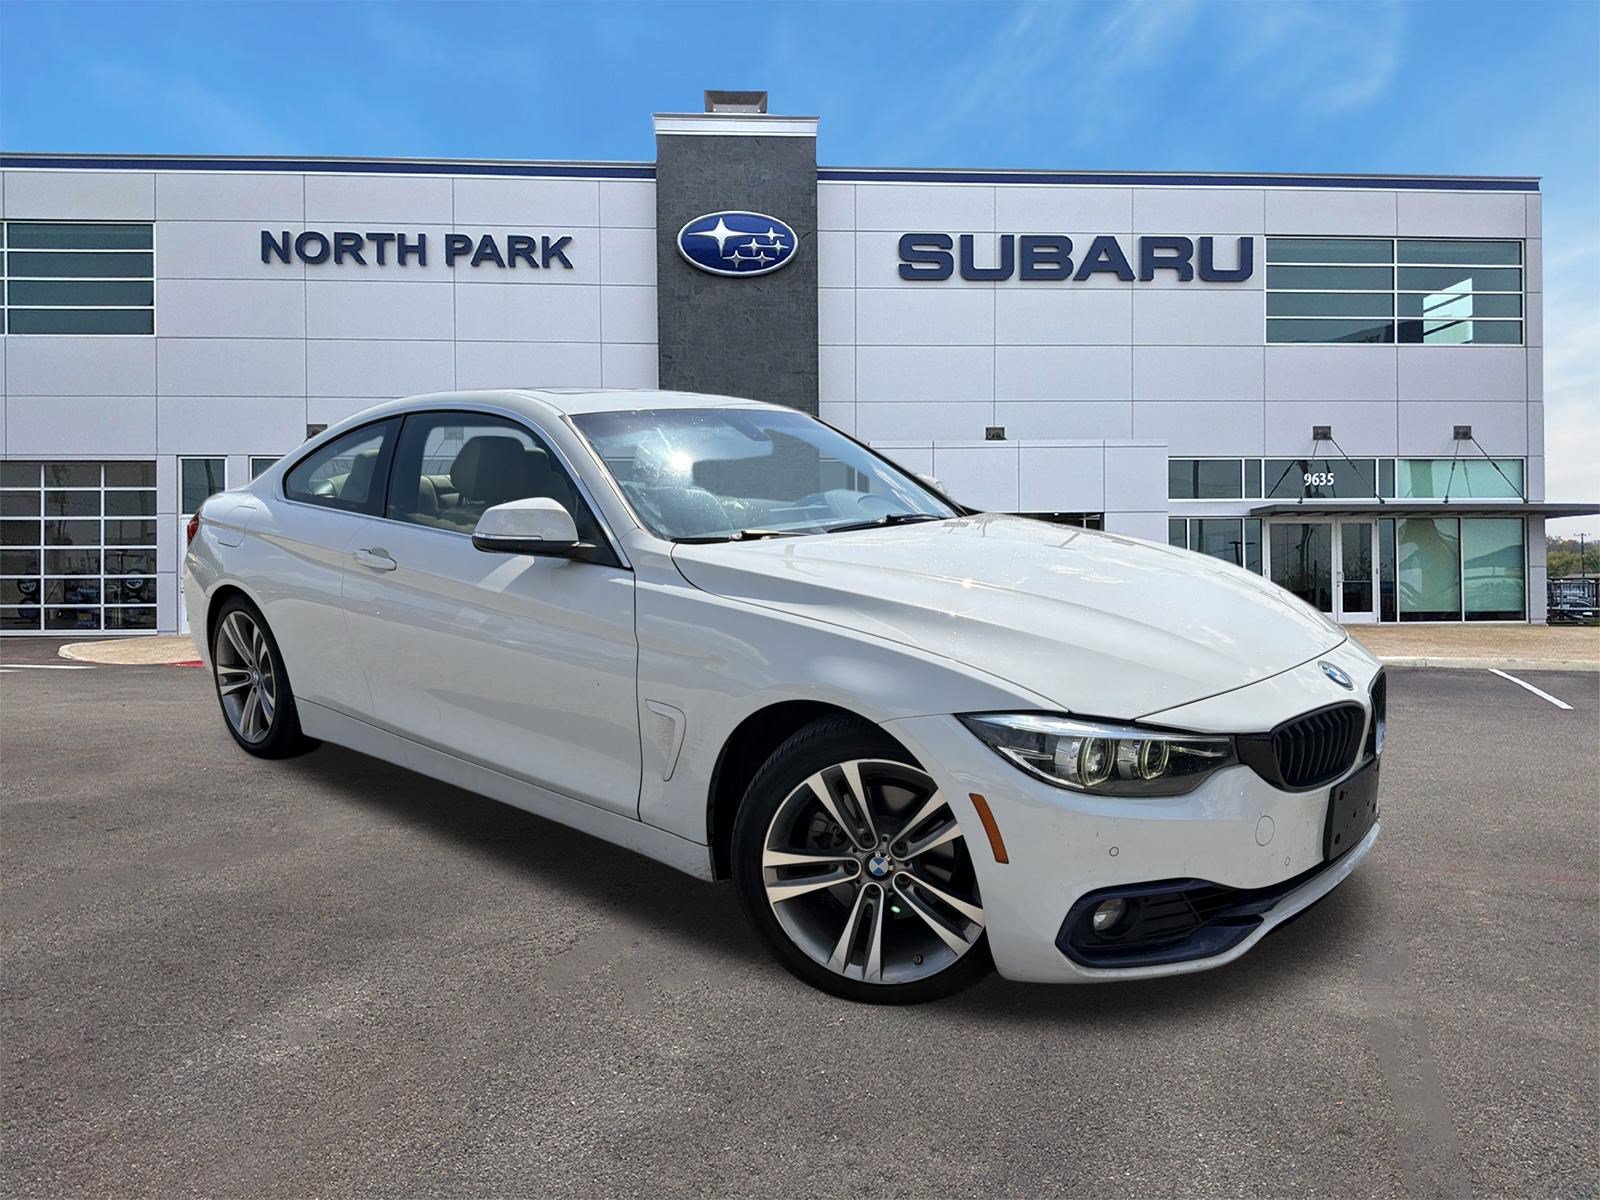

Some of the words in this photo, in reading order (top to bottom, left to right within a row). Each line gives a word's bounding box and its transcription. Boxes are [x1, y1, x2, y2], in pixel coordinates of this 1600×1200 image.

[261, 230, 427, 267] NORTH
[445, 233, 574, 269] PARK
[898, 233, 1254, 282] SUBARU
[1303, 472, 1335, 487] 9635
